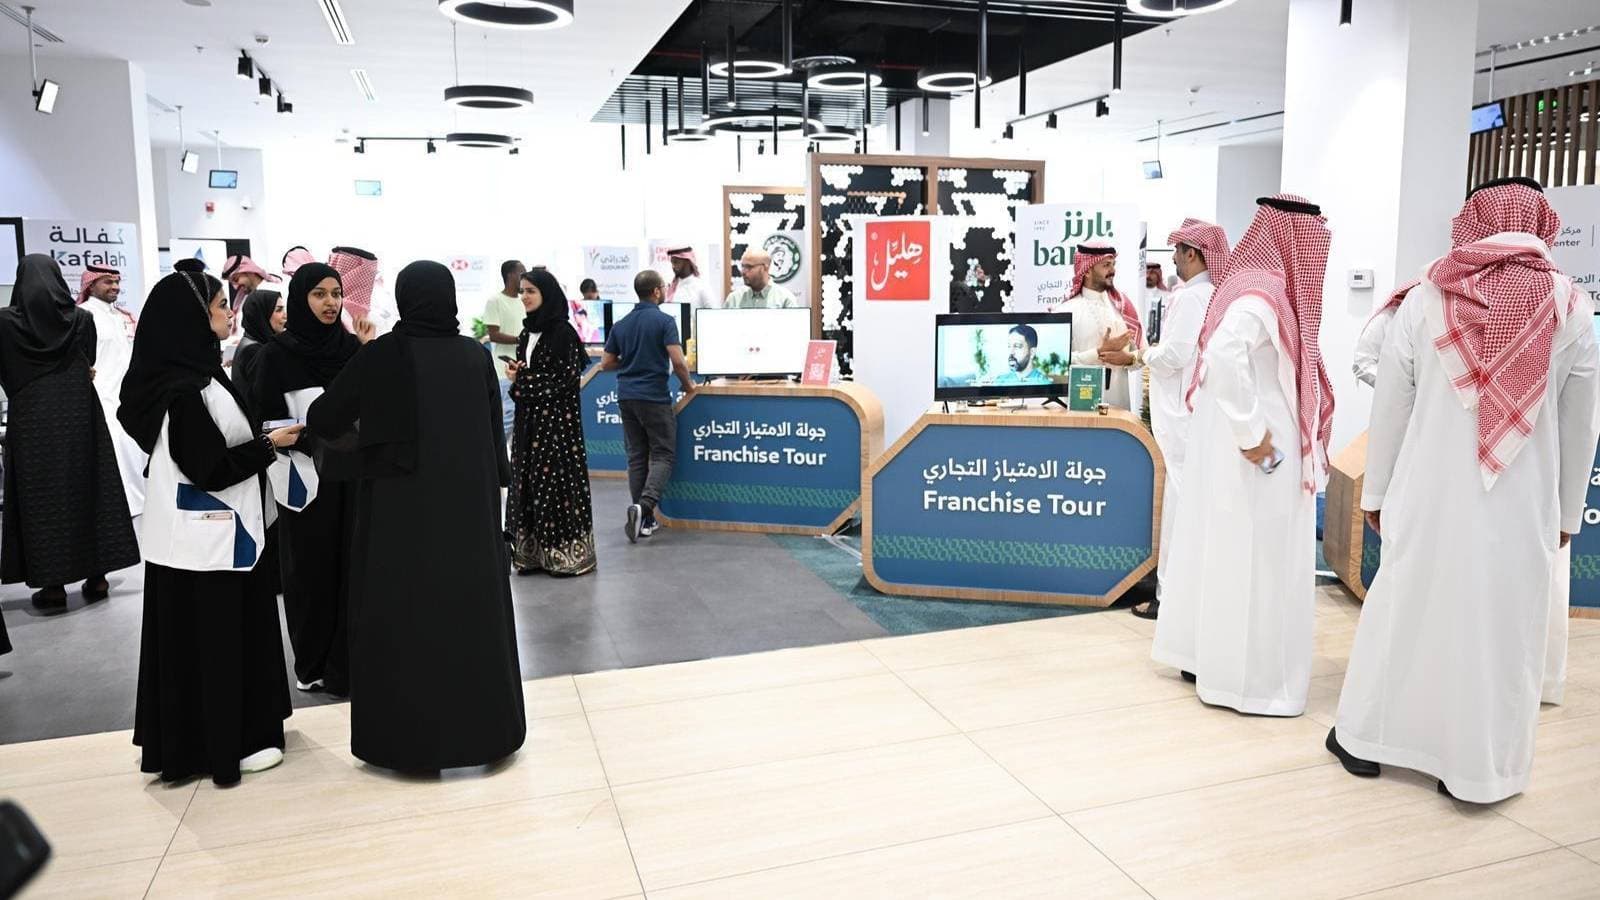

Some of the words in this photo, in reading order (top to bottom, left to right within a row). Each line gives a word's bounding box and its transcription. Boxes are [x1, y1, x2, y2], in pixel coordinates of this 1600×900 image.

[49, 225, 124, 244] كفالة
[1061, 211, 1114, 243] بارنز
[1561, 226, 1581, 236] مركز
[1553, 239, 1581, 247] enter
[50, 249, 127, 267] Kafalah
[692, 419, 741, 441] التجاري
[743, 420, 791, 440] الامتياز
[795, 422, 827, 442] جولة
[693, 444, 780, 464] Franchise
[783, 448, 827, 466] Tour
[922, 457, 987, 484] التجاري
[992, 458, 1058, 483] الامتياز
[1065, 460, 1107, 486] جولة
[923, 489, 1041, 514] Franchise
[1047, 494, 1107, 517] Tour
